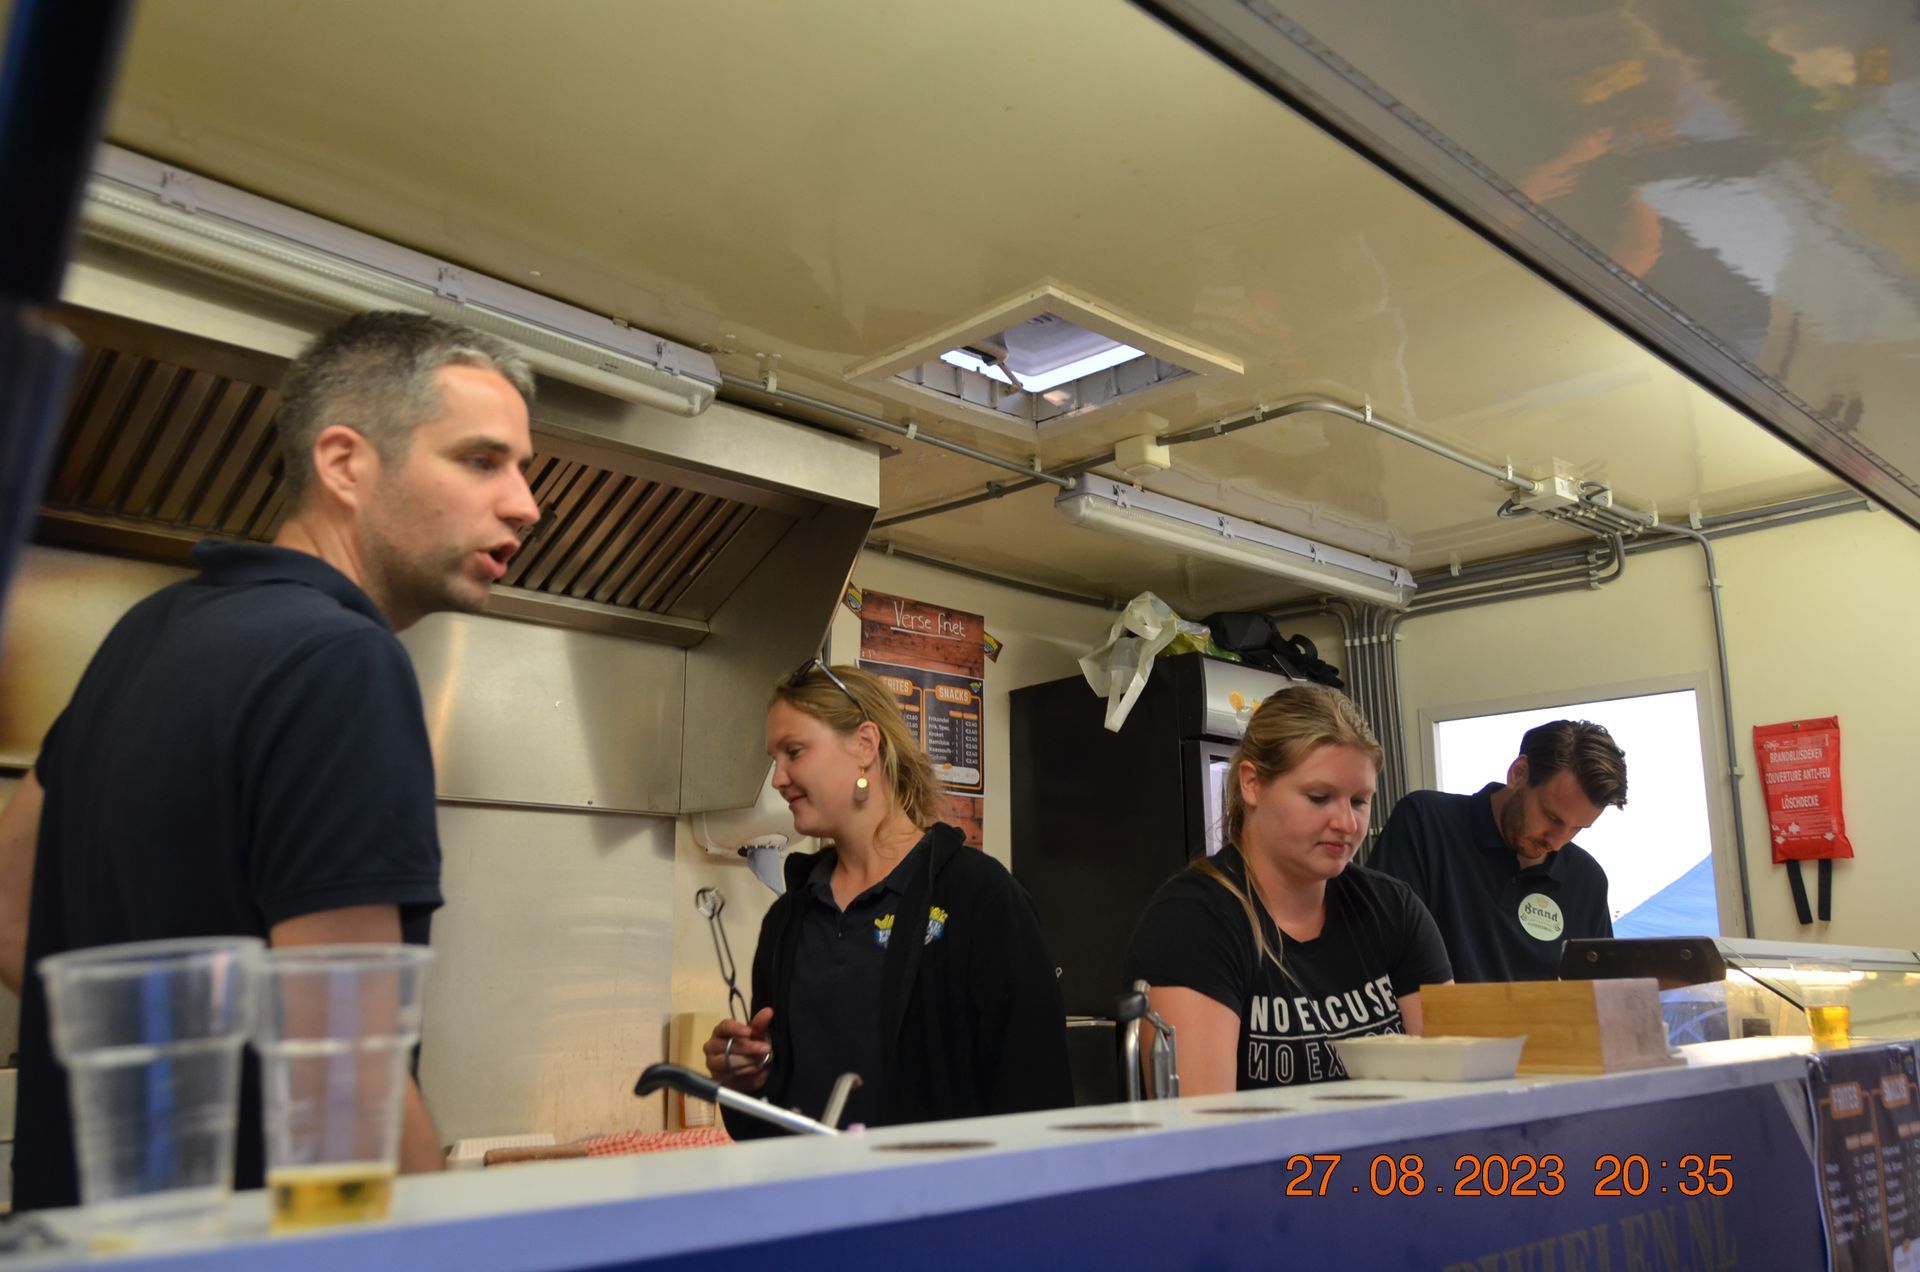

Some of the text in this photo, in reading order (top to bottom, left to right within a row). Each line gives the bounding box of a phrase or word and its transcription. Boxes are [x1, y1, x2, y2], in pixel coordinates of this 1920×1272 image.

[894, 600, 966, 638] Verse friet
[939, 687, 969, 702] SNACKS
[1769, 748, 1823, 763] BRANDBLUSDEKEN
[1766, 767, 1830, 785] COUVERTURE ANTI-FEU
[1781, 794, 1820, 809] LÖSCHDECKE
[1524, 902, 1558, 922] Brand
[1250, 995, 1290, 1033] NO
